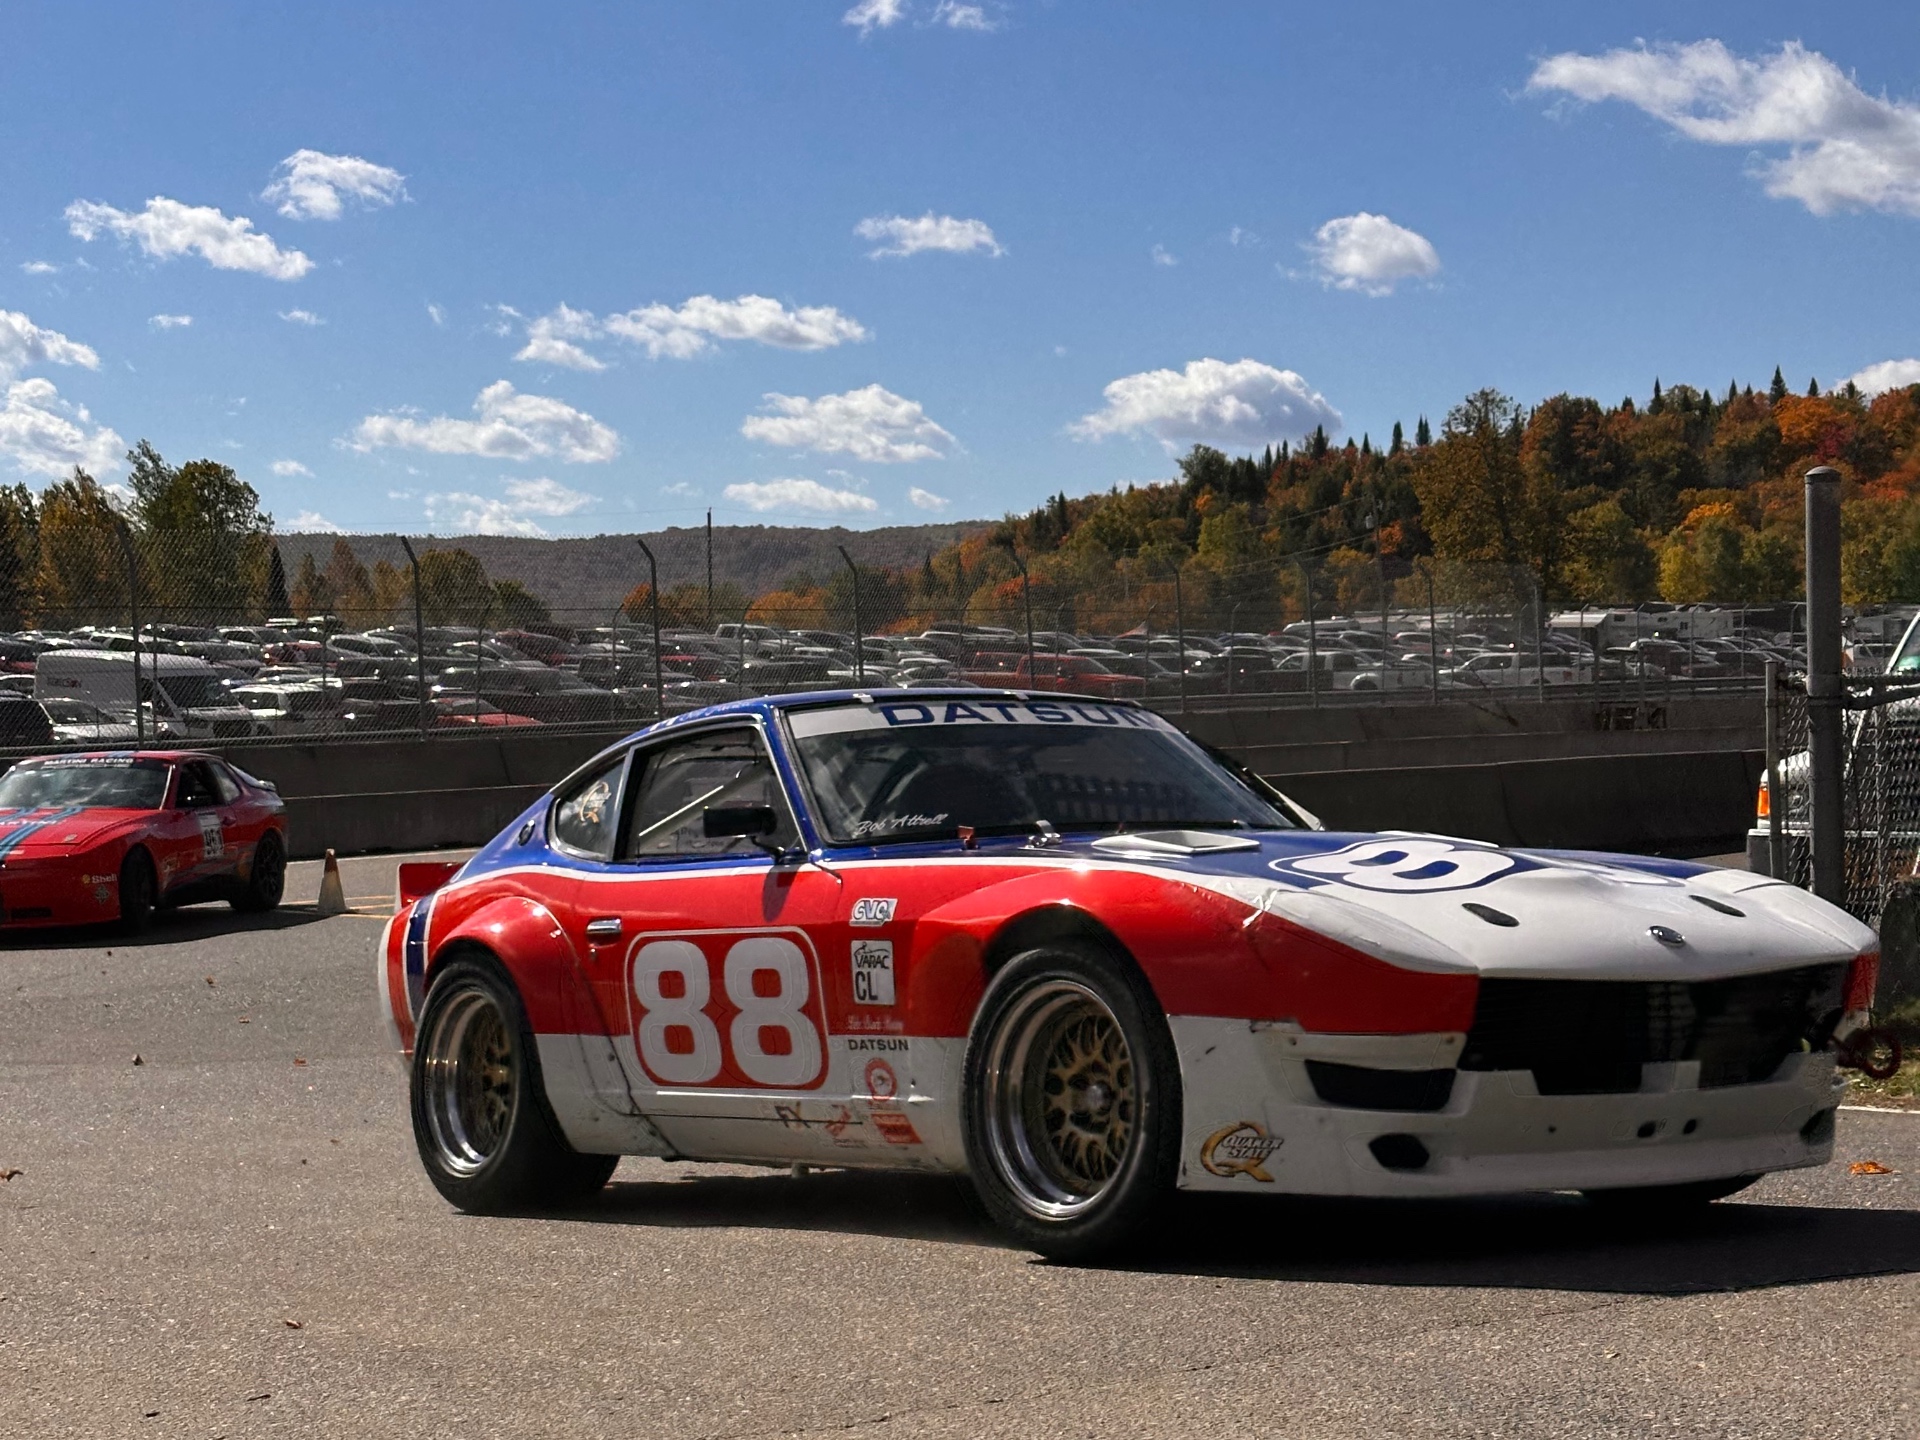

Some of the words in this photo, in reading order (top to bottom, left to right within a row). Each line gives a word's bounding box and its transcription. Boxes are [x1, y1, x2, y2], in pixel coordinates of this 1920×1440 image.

[879, 701, 1156, 727] DATSUN
[856, 819, 888, 835] Bob
[91, 873, 118, 884] Shell
[854, 953, 891, 970] VARAC
[855, 970, 879, 1001] CL
[633, 937, 823, 1086] 88
[847, 1038, 910, 1051] DATSUN
